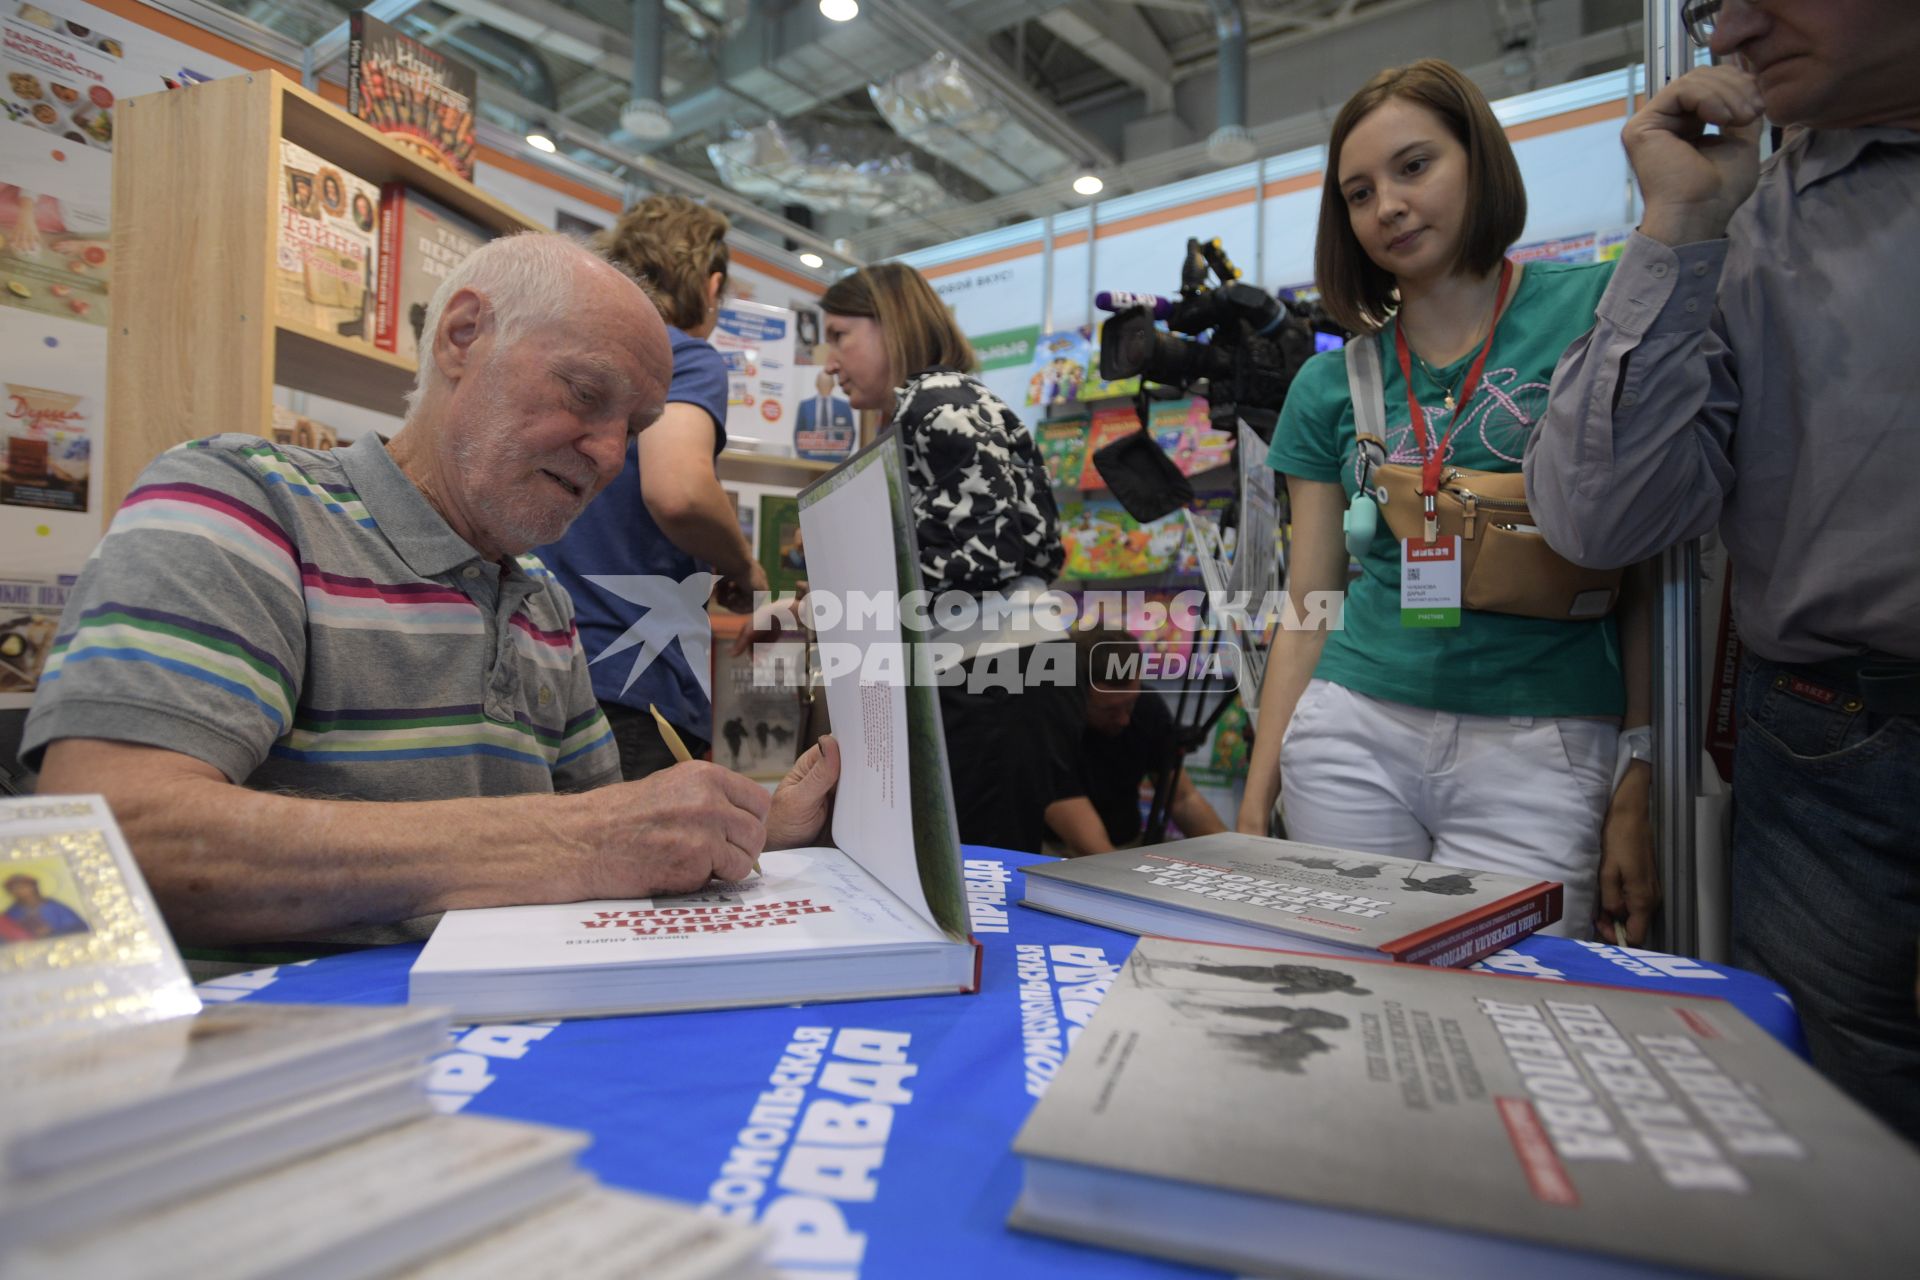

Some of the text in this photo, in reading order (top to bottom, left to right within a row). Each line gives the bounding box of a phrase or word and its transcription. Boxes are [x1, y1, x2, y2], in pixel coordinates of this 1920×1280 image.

[3, 39, 104, 82] МОЛОДОСТИ
[4, 26, 76, 62] ТАРЕЛКА
[281, 204, 365, 259] Тайна
[963, 860, 1013, 933] ПРАВДА
[1132, 864, 1388, 918] ПЕРЕВАЛА
[1148, 876, 1308, 914] ТАЙНА
[1166, 862, 1394, 906] ДЯТЛОВА
[580, 905, 836, 929] ПЕРЕВАЛА
[594, 898, 813, 920] ДЯТЛОВА
[632, 917, 798, 936] ТАЙНА
[1518, 910, 1543, 932] ТАЙНА
[1475, 921, 1517, 950] ПЕРЕВАЛА
[1473, 997, 1636, 1162] ДЯТЛОВА
[1542, 998, 1750, 1193] ПЕРЕВАЛА
[1633, 1032, 1806, 1160] ТАЙНА
